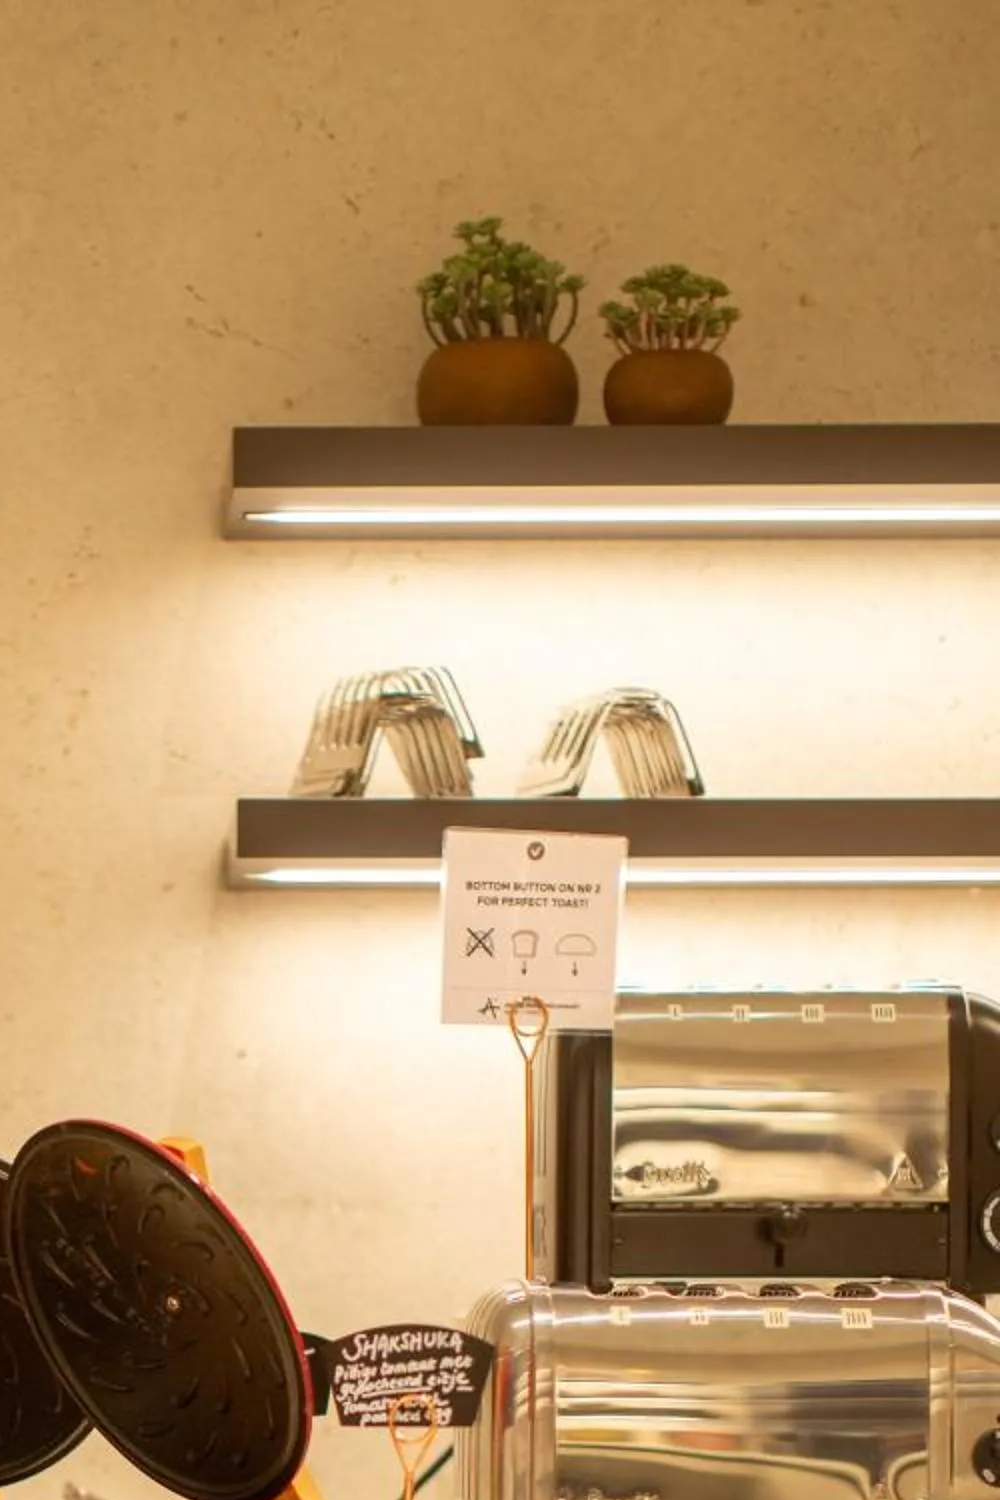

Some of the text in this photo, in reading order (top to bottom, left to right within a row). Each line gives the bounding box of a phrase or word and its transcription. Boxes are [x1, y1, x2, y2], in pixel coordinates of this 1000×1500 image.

[465, 881, 602, 894] BOTTOM BUTTON ON NR 2
[477, 896, 589, 909] FOR PERFECT TOAST!
[341, 1330, 463, 1362] SHAKSHUKA
